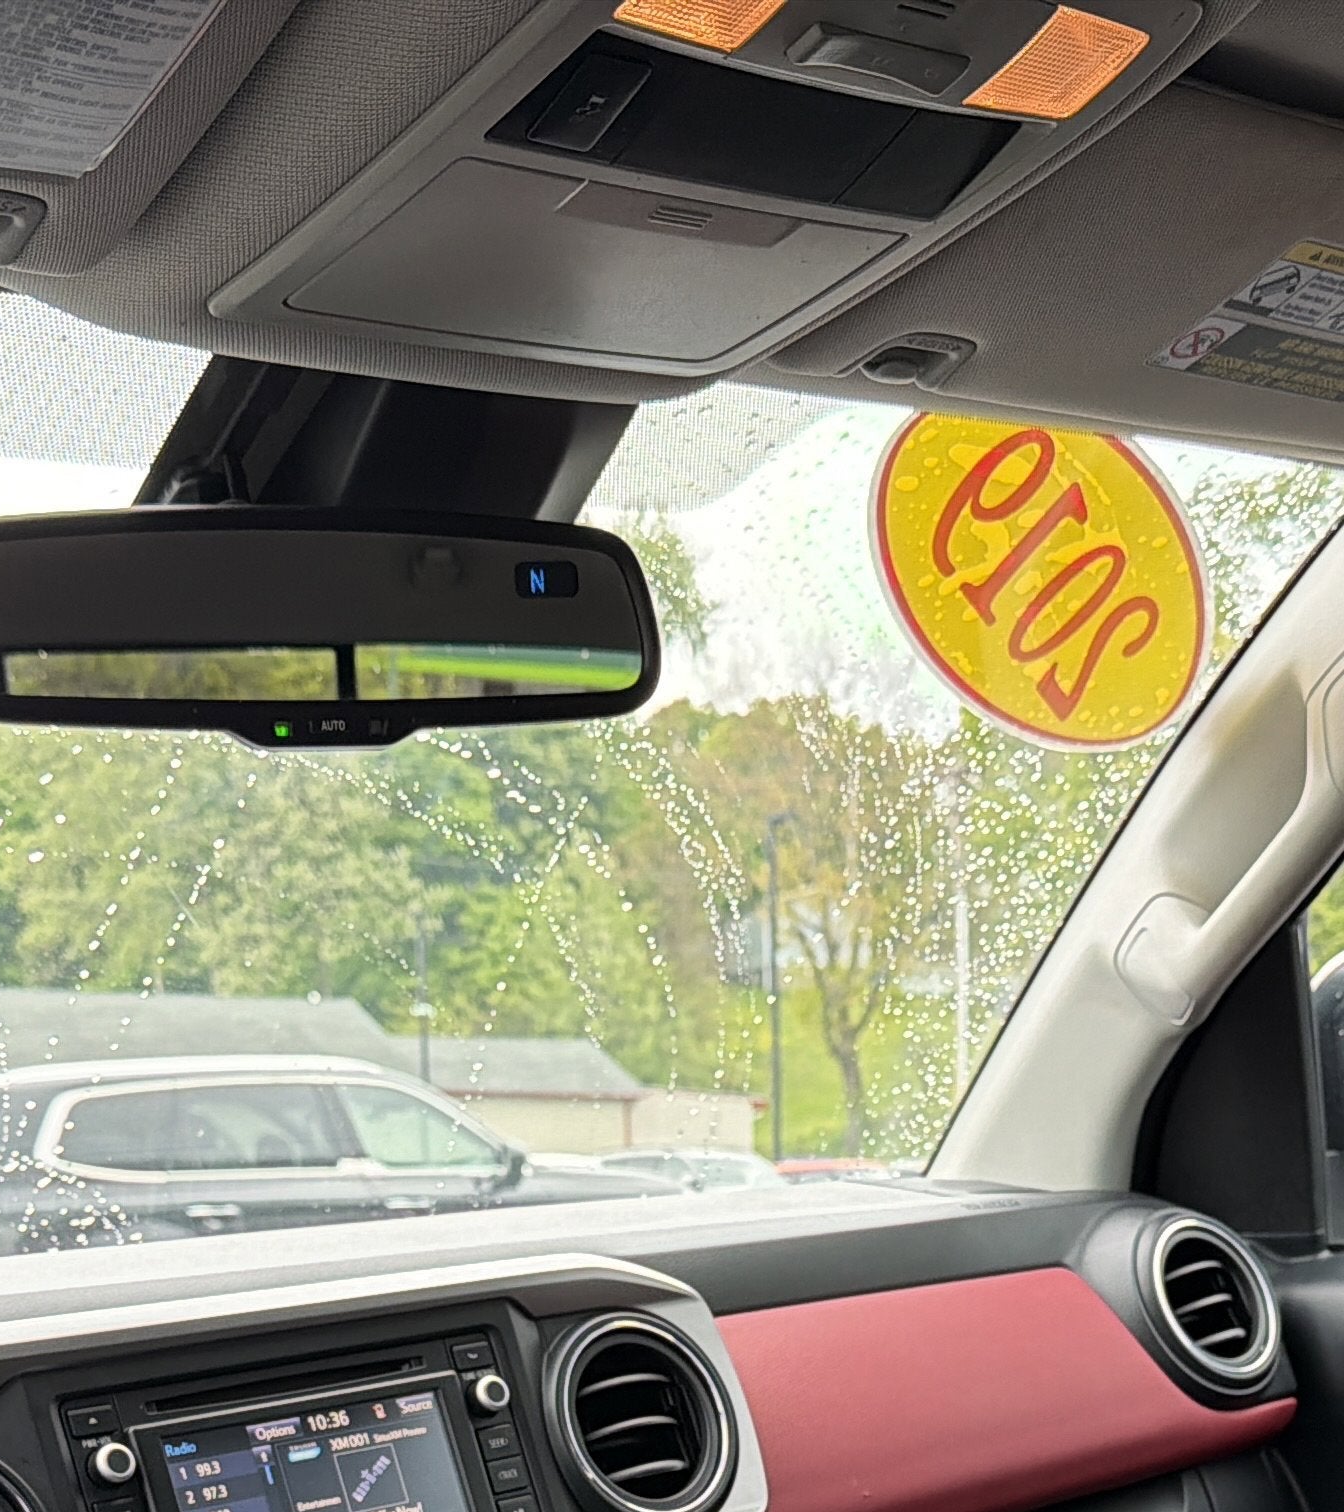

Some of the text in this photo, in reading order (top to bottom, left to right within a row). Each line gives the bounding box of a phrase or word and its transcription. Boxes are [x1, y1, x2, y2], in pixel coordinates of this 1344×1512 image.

[529, 568, 546, 594] N
[319, 720, 346, 733] AUTO
[399, 1400, 433, 1415] Source
[306, 1409, 351, 1432] 10:36
[255, 1423, 297, 1441] Options
[164, 1442, 197, 1457] Radio
[179, 1460, 222, 1481] 1 99.3
[185, 1484, 228, 1505] 2 97.3
